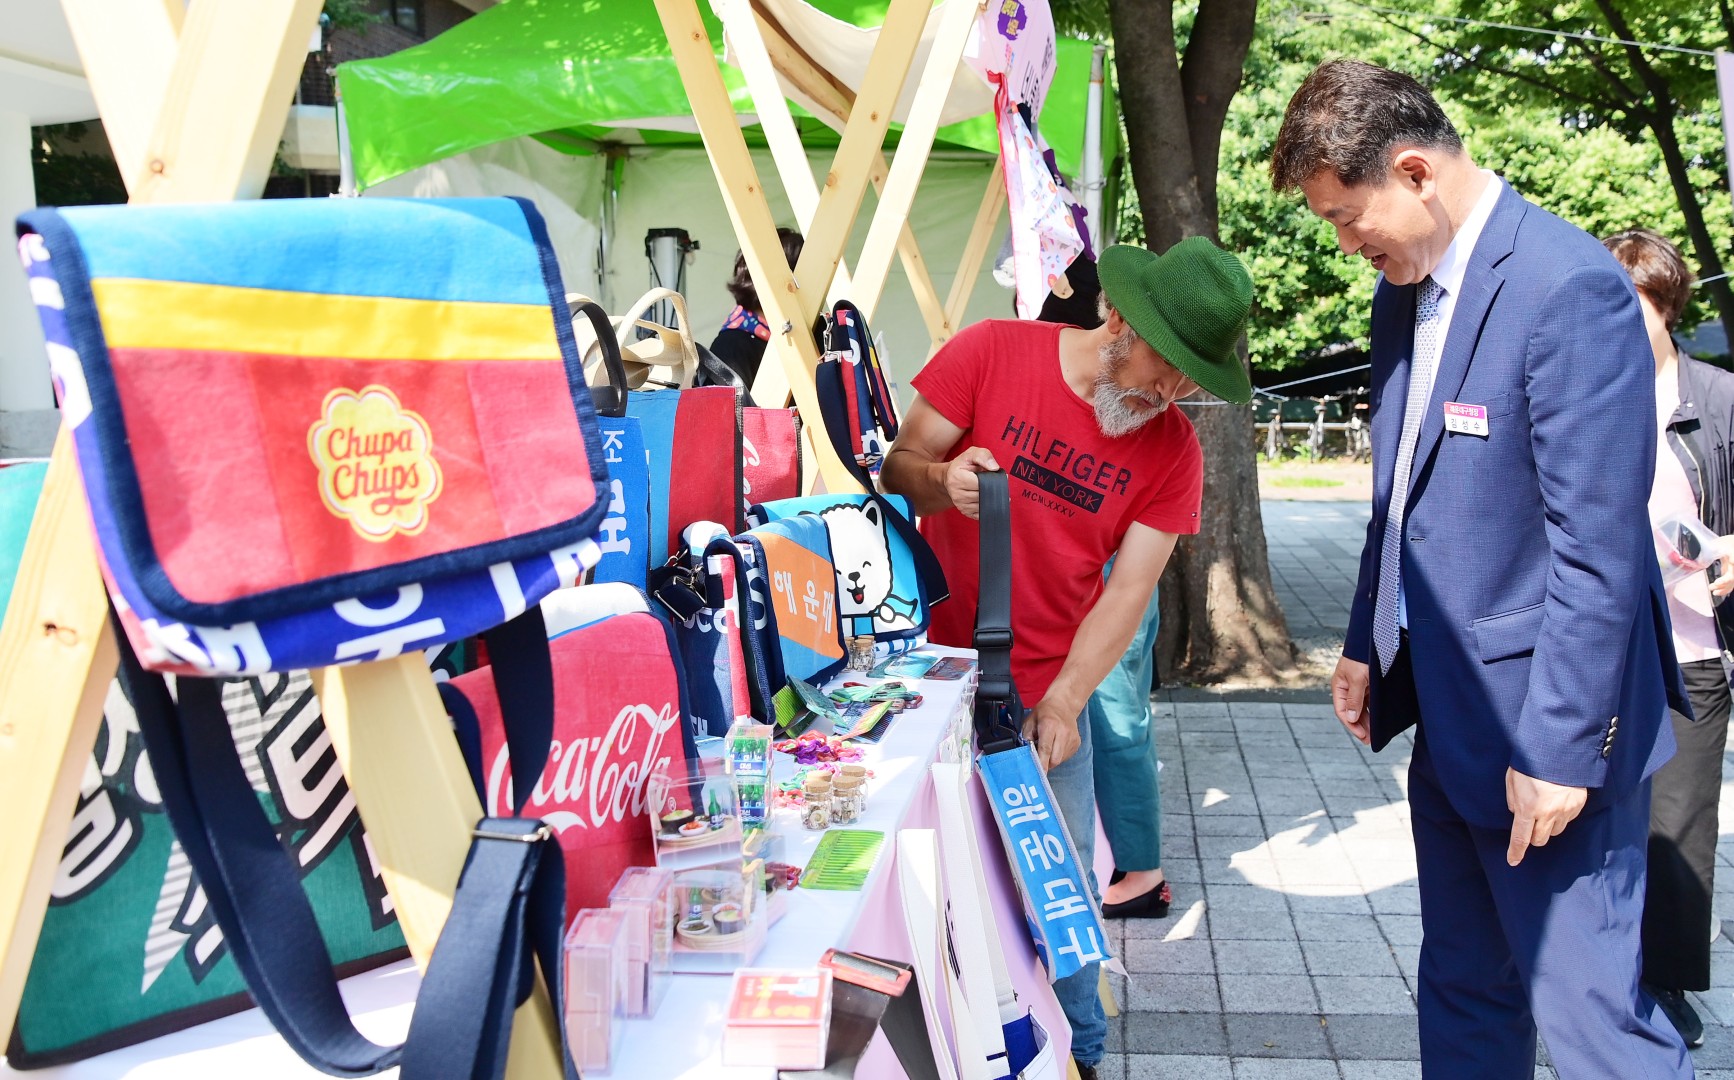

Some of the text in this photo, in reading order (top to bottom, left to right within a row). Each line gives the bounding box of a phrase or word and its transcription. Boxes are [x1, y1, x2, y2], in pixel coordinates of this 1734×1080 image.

[328, 426, 413, 465] Chupa
[1001, 415, 1131, 496] HILFIGER
[333, 461, 420, 516] Chups
[1016, 461, 1100, 511] NEW YORK
[1021, 488, 1077, 519] MCMLXXXV
[773, 570, 835, 634] 해운대
[1002, 783, 1104, 967] 해운대구
